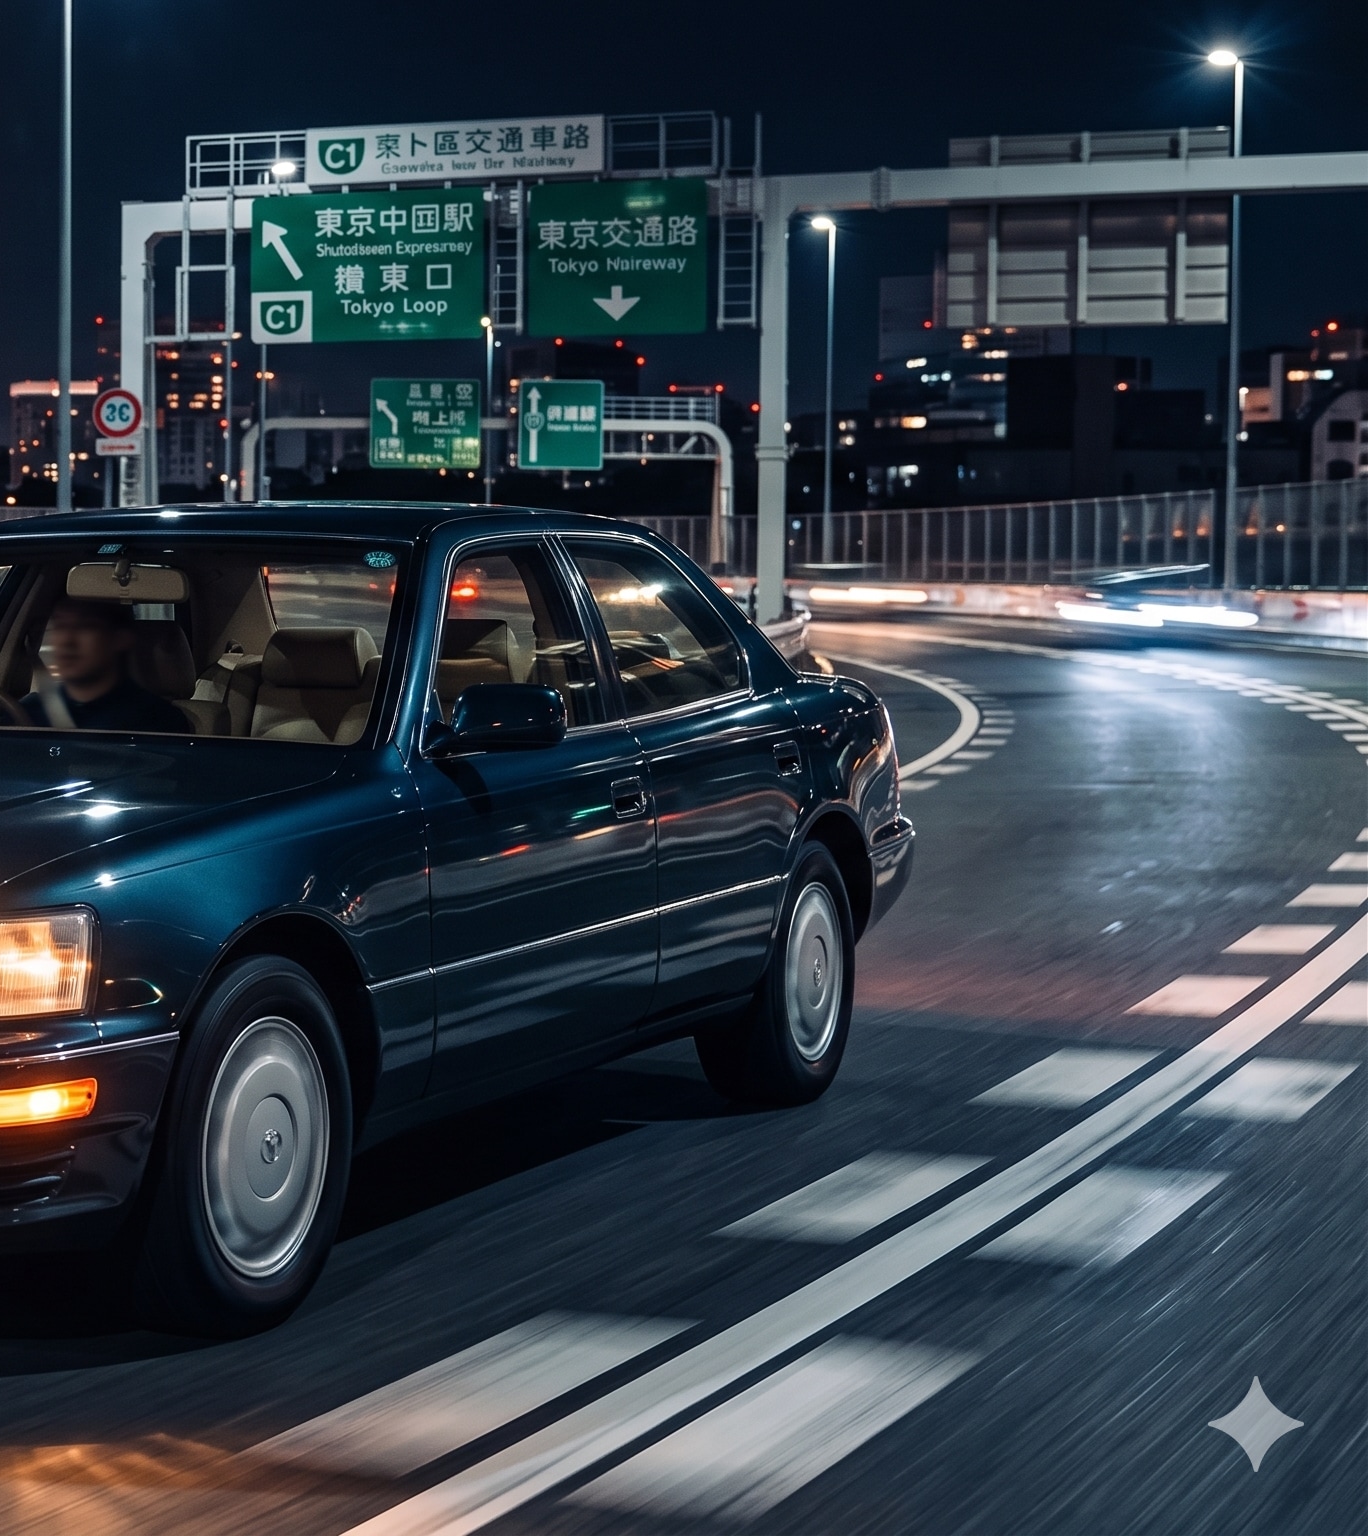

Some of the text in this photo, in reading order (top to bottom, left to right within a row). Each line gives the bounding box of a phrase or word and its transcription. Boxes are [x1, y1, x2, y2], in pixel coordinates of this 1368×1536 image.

[324, 142, 356, 169] C1
[537, 214, 698, 250] 東京交通路
[548, 257, 599, 276] Tokyo
[265, 304, 297, 330] C1
[340, 298, 448, 318] Tokyo Loop
